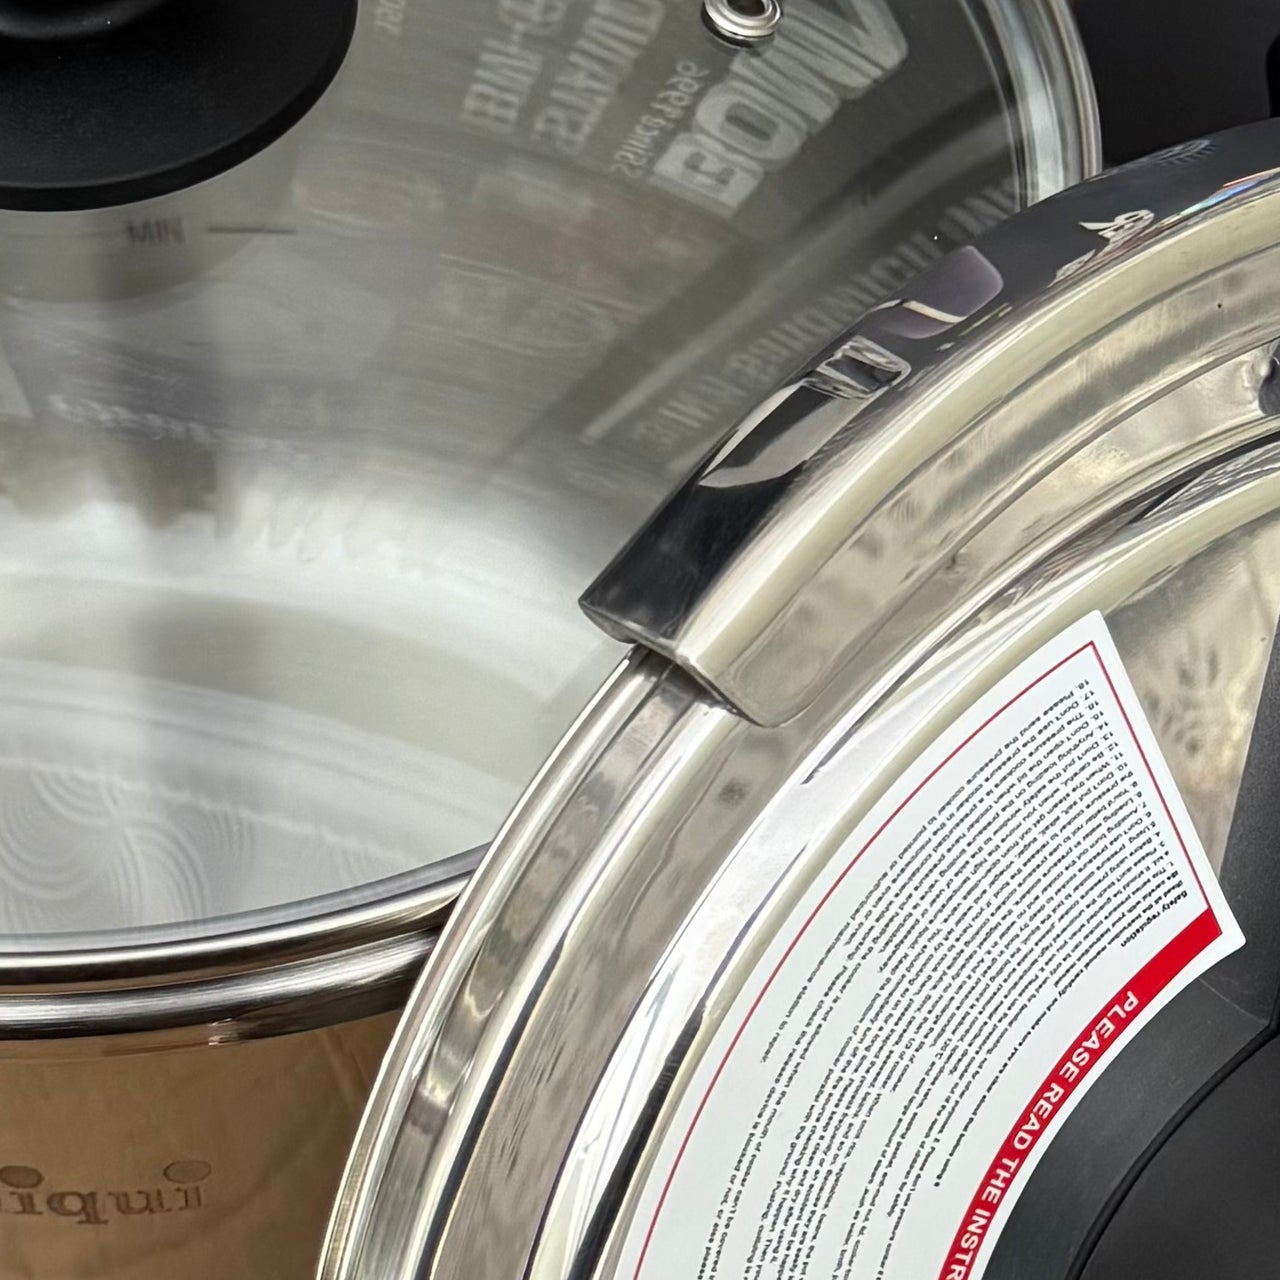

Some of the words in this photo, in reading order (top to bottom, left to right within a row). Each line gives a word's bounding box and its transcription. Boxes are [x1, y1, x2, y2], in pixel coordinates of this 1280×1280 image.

[126, 218, 185, 245] MIN
[1056, 988, 1140, 1083] PLEASE
[1008, 1080, 1065, 1152] READ
[981, 1151, 1020, 1200] THE
